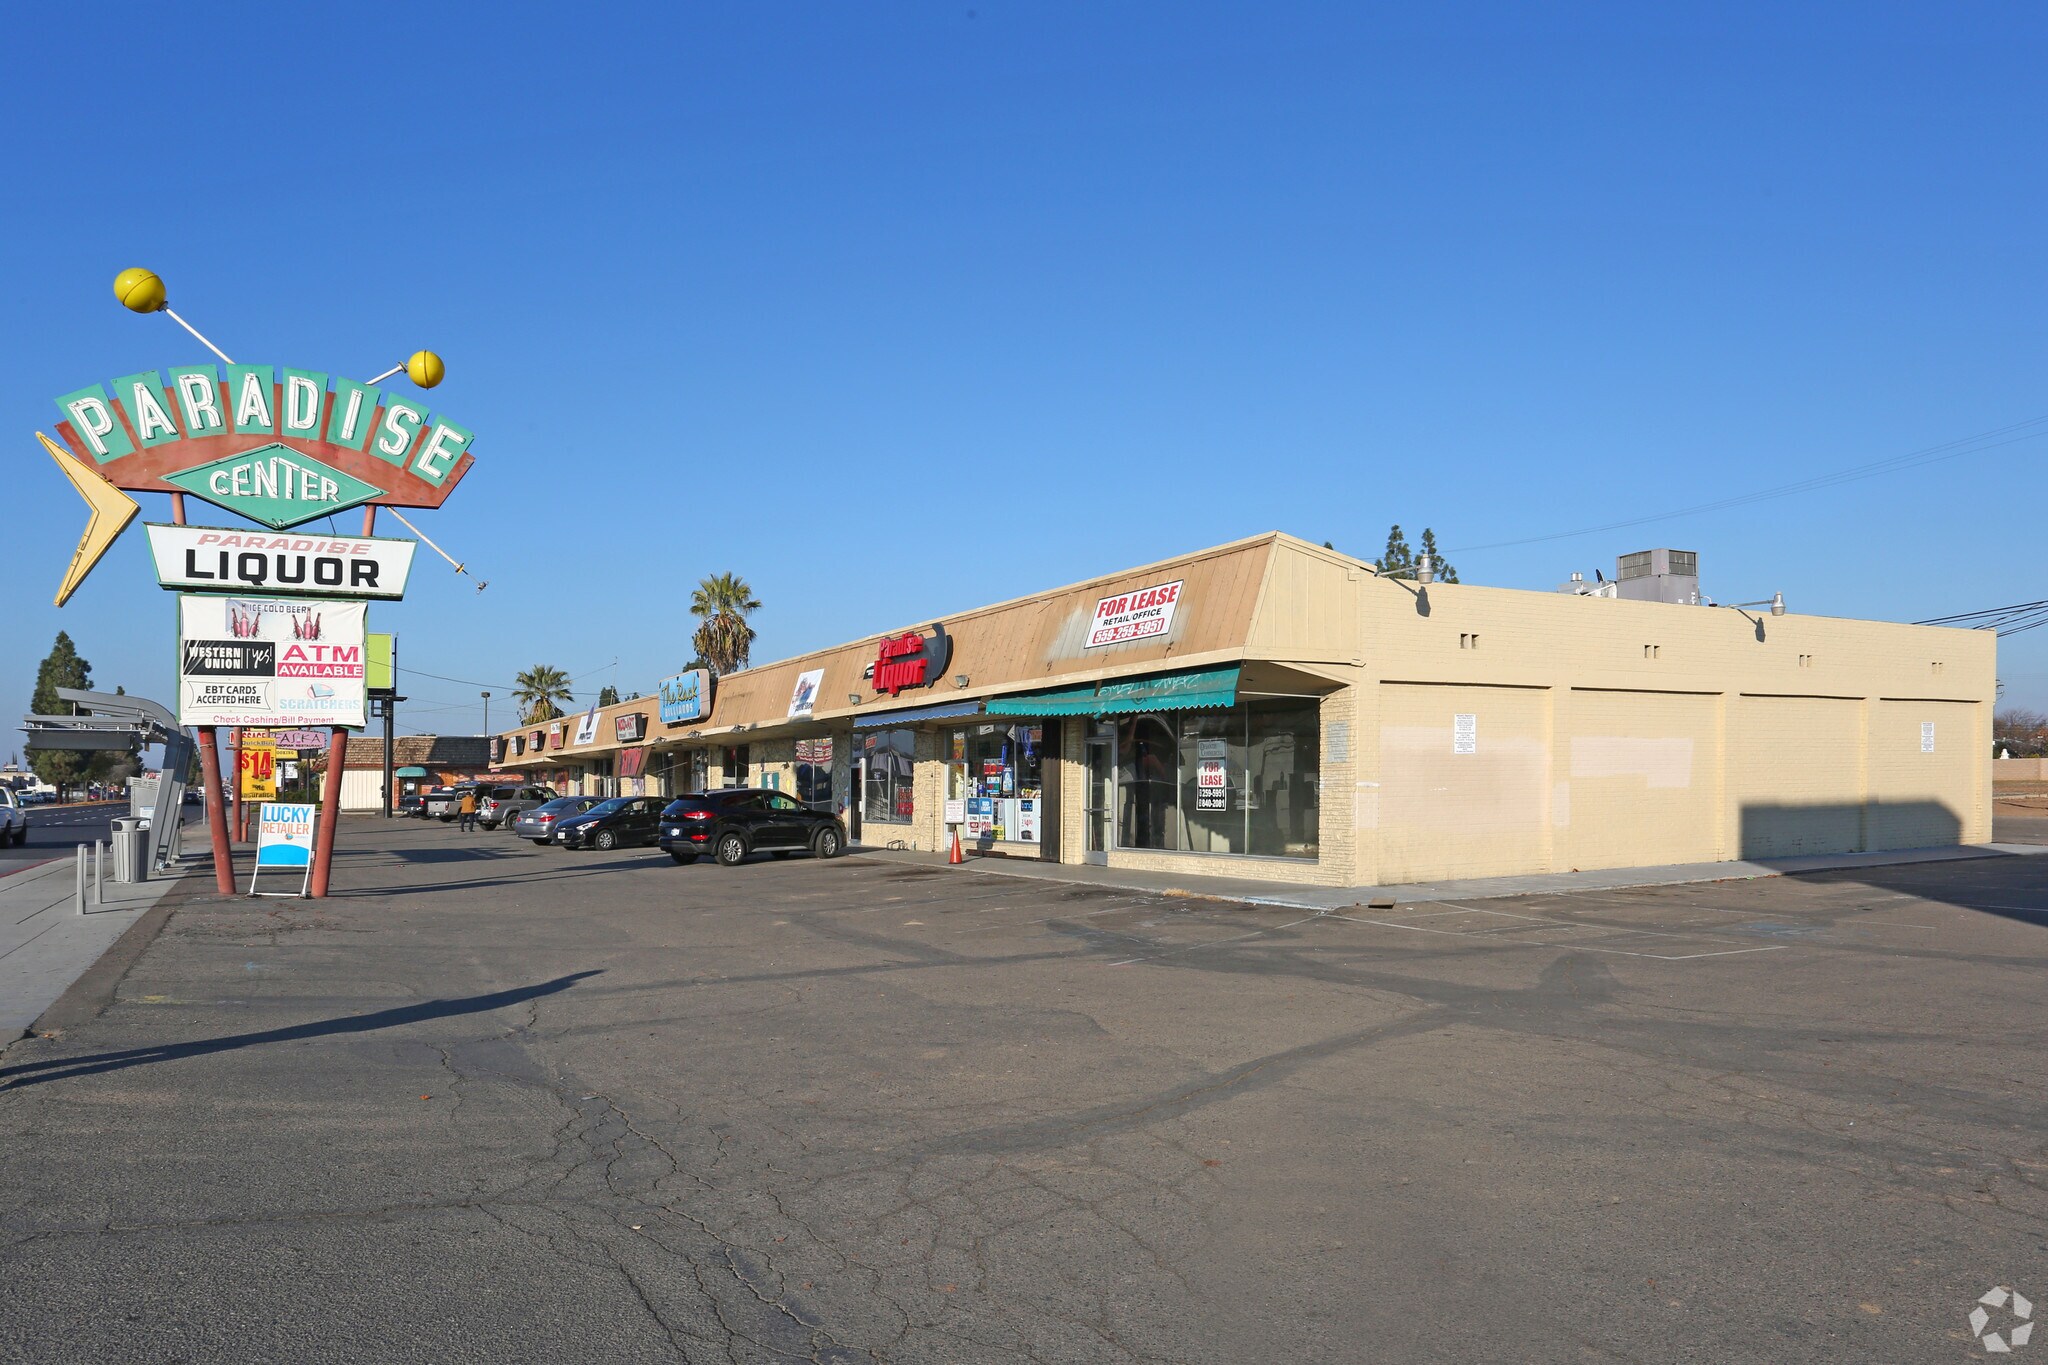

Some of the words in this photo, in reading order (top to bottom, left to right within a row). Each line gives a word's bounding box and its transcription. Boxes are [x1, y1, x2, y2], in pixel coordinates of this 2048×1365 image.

[68, 372, 467, 479] PARADISE
[209, 456, 340, 503] CENTER
[197, 533, 372, 555] PARADISE
[186, 548, 380, 588] LIQUOR
[249, 604, 262, 612] ICE
[264, 605, 285, 613] COLD
[286, 605, 307, 614] BEER
[1097, 597, 1128, 618] FOR
[1129, 585, 1179, 611] LEASE
[1094, 619, 1164, 643] 559-259-5951
[189, 646, 241, 658] WESTERN
[282, 644, 359, 662] ATM
[879, 633, 924, 658] Paradise
[204, 658, 241, 669] UNION
[252, 645, 273, 669] yes!
[278, 665, 363, 676] AVAILABLE
[872, 658, 928, 694] Liquor
[205, 685, 225, 694] EBT
[226, 685, 257, 695] CARDS
[661, 681, 677, 708] The
[196, 695, 237, 704] ACCEPTED
[238, 695, 262, 704] HERE
[280, 699, 360, 710] SCRATCHERS
[213, 715, 240, 724] Check
[243, 715, 296, 726] Cashing/Bill
[297, 716, 335, 725] Payment
[1204, 761, 1219, 773] FOR
[1200, 774, 1223, 786] LEASE
[263, 806, 311, 823] LUCKY
[262, 822, 310, 834] RETAILER
